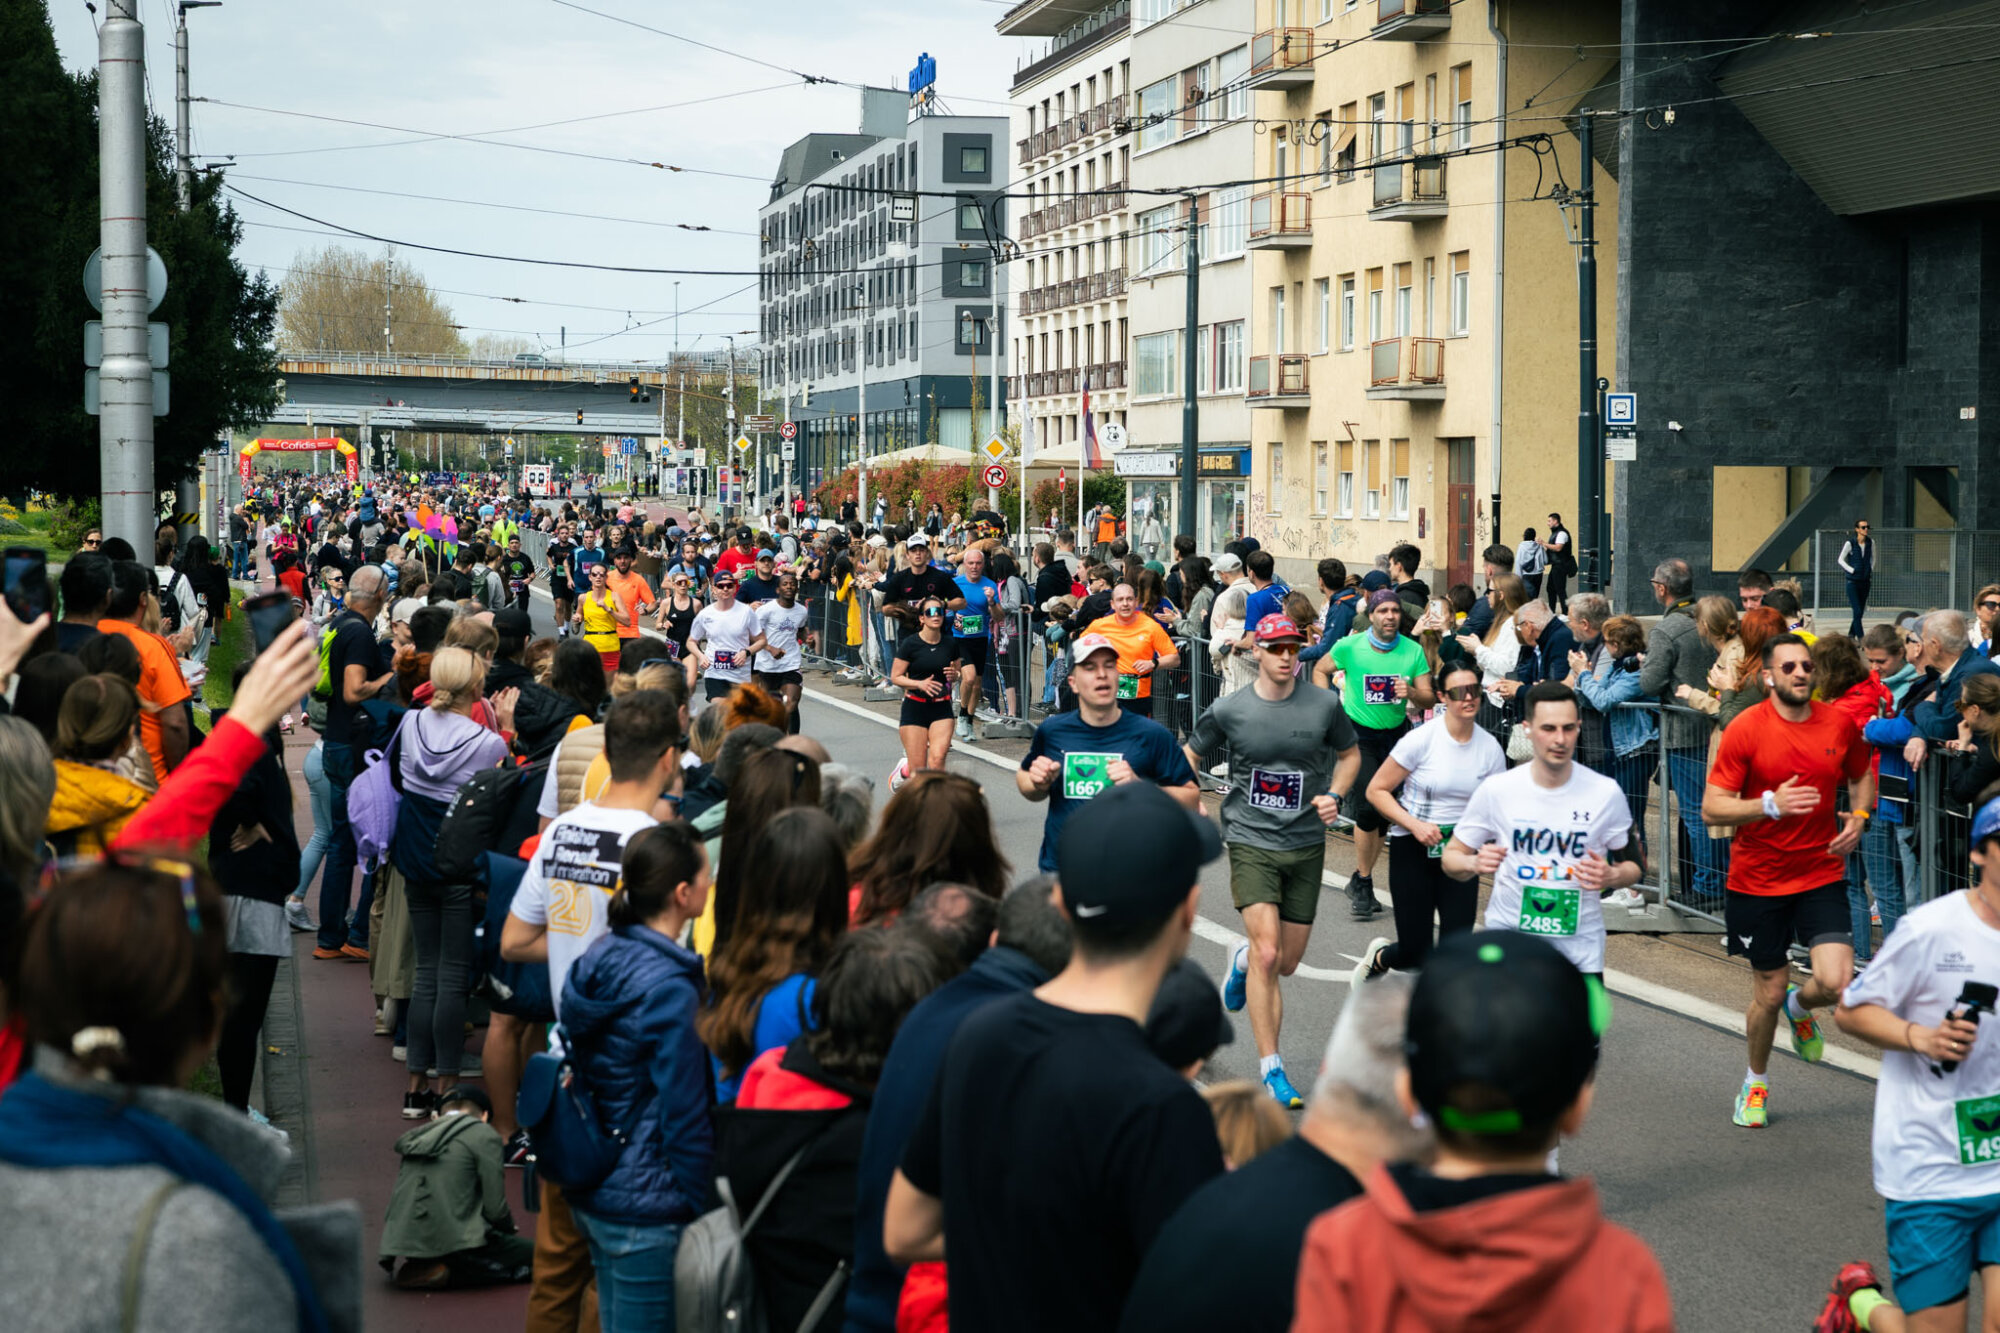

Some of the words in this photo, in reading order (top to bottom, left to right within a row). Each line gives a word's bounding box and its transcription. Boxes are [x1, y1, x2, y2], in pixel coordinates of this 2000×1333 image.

[1599, 379, 1606, 390] F
[280, 441, 316, 450] Cofidis
[1365, 692, 1385, 702] 842
[1253, 792, 1286, 808] 1280
[1512, 828, 1588, 858] MOVE
[1521, 914, 1562, 934] 2485
